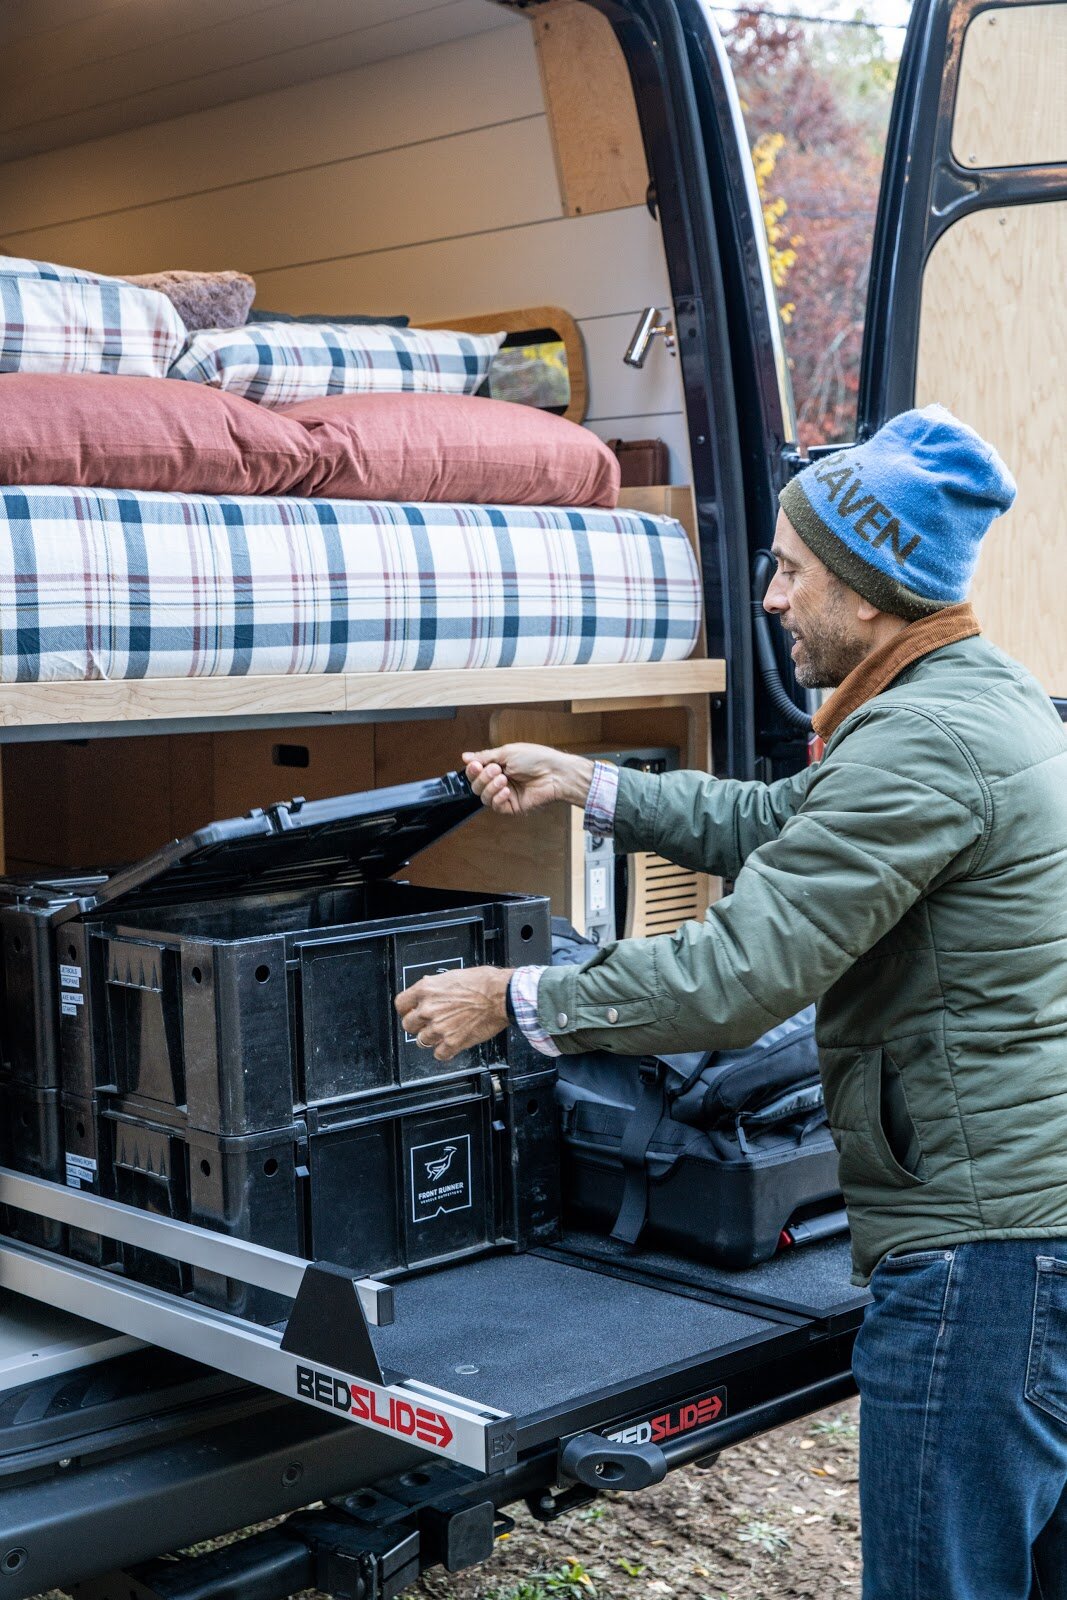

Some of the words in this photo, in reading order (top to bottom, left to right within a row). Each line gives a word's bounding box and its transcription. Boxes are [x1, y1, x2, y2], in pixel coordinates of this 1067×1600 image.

[419, 1188, 437, 1200] FRONT
[438, 1182, 464, 1194] RUNNER
[297, 1364, 453, 1448] BEDSLIDE
